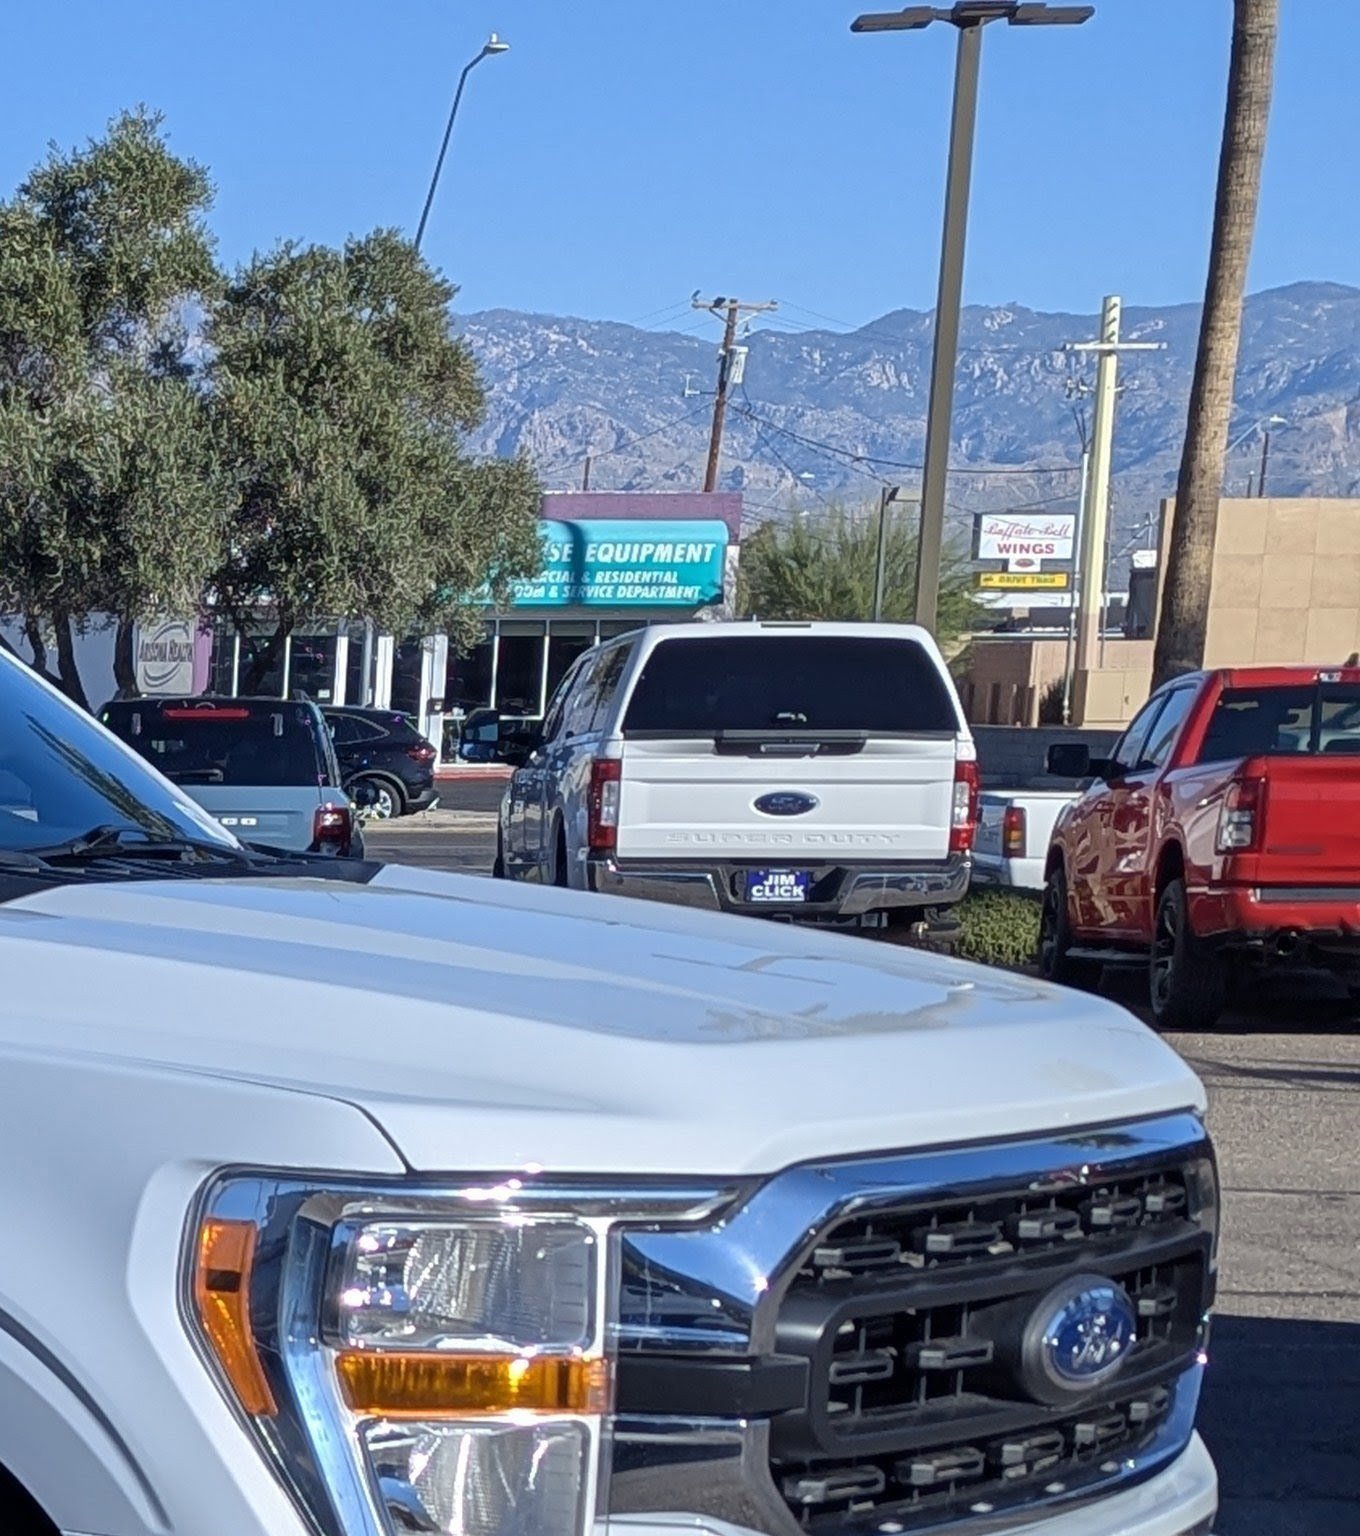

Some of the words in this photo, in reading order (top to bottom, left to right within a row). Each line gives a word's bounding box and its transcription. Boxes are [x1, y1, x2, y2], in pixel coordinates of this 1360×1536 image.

[585, 542, 716, 564] EQUIPMENT
[997, 543, 1055, 554] WINGS
[594, 570, 679, 584] RESIDENTIAL
[549, 586, 559, 599] &
[563, 585, 613, 599] SERVICE
[616, 585, 702, 599] DEPARTMENT
[667, 832, 793, 845] SUPER
[802, 832, 902, 845] DUTY
[762, 873, 796, 886] JIM
[751, 884, 805, 897] CLICK
